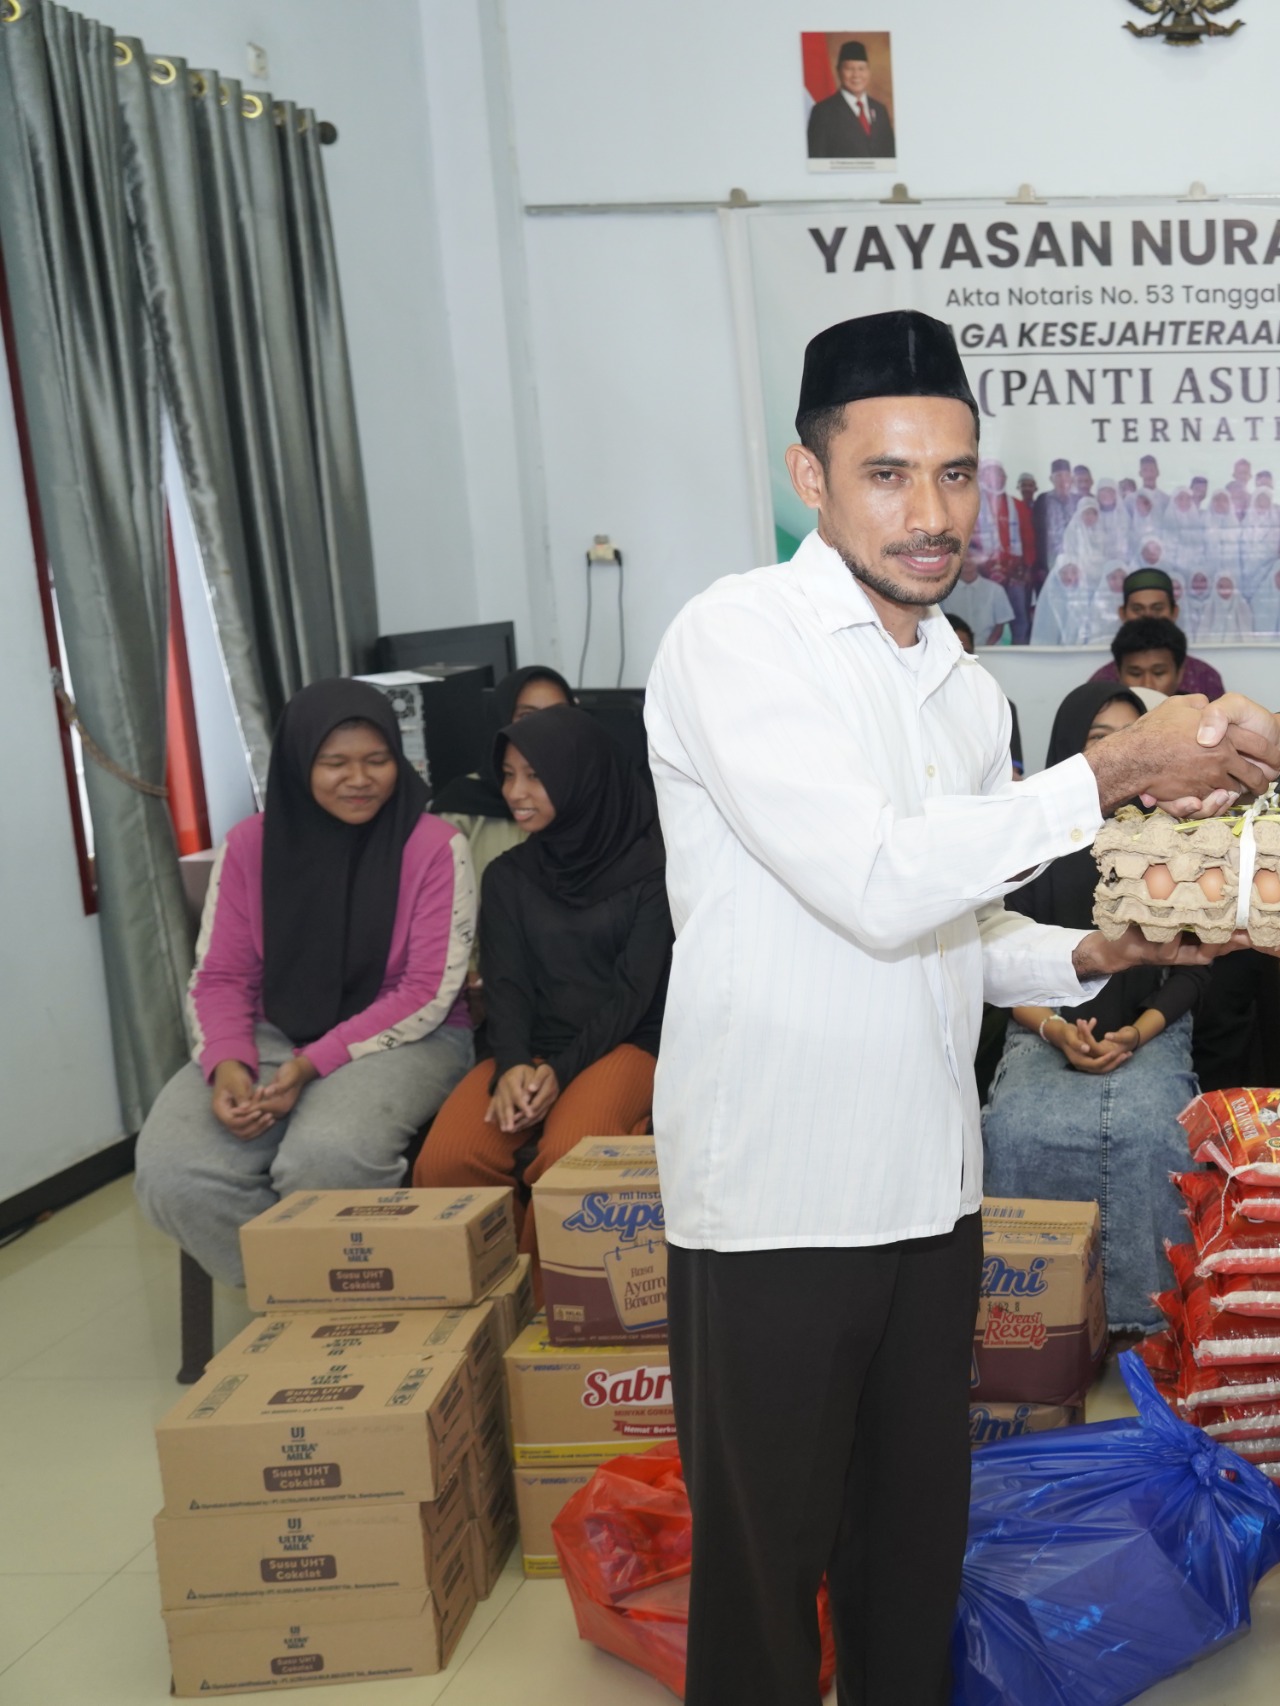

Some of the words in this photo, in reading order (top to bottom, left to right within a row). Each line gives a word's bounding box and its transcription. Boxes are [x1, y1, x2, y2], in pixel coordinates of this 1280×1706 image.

[807, 221, 1112, 273] YAYASAN
[946, 287, 1000, 307] Akta
[1008, 285, 1094, 306] Notaris
[1101, 286, 1138, 305] No.
[1145, 284, 1174, 304] 53
[978, 367, 1155, 417] (PANTI
[336, 1271, 360, 1279] Susu
[362, 1270, 385, 1279] UHT
[631, 1265, 654, 1278] Rasa
[342, 1281, 381, 1290] Cokelat
[624, 1276, 667, 1297] Ayam
[624, 1292, 667, 1311] Bawan
[1002, 1312, 1041, 1323] Kreasi
[985, 1320, 1046, 1342] Resep
[284, 1389, 318, 1398] Susu
[321, 1386, 353, 1395] UHT
[647, 1407, 674, 1416] GOREN
[281, 1444, 317, 1453] ULTRA
[287, 1452, 312, 1461] MILK
[272, 1469, 301, 1478] Susu
[304, 1466, 330, 1476] UHT
[280, 1478, 326, 1488] Cokelat
[278, 1535, 313, 1544] ULTRA
[283, 1543, 309, 1551] MILK
[269, 1560, 297, 1570] Susu
[300, 1558, 325, 1568] UHT
[276, 1570, 321, 1580] Cokelat
